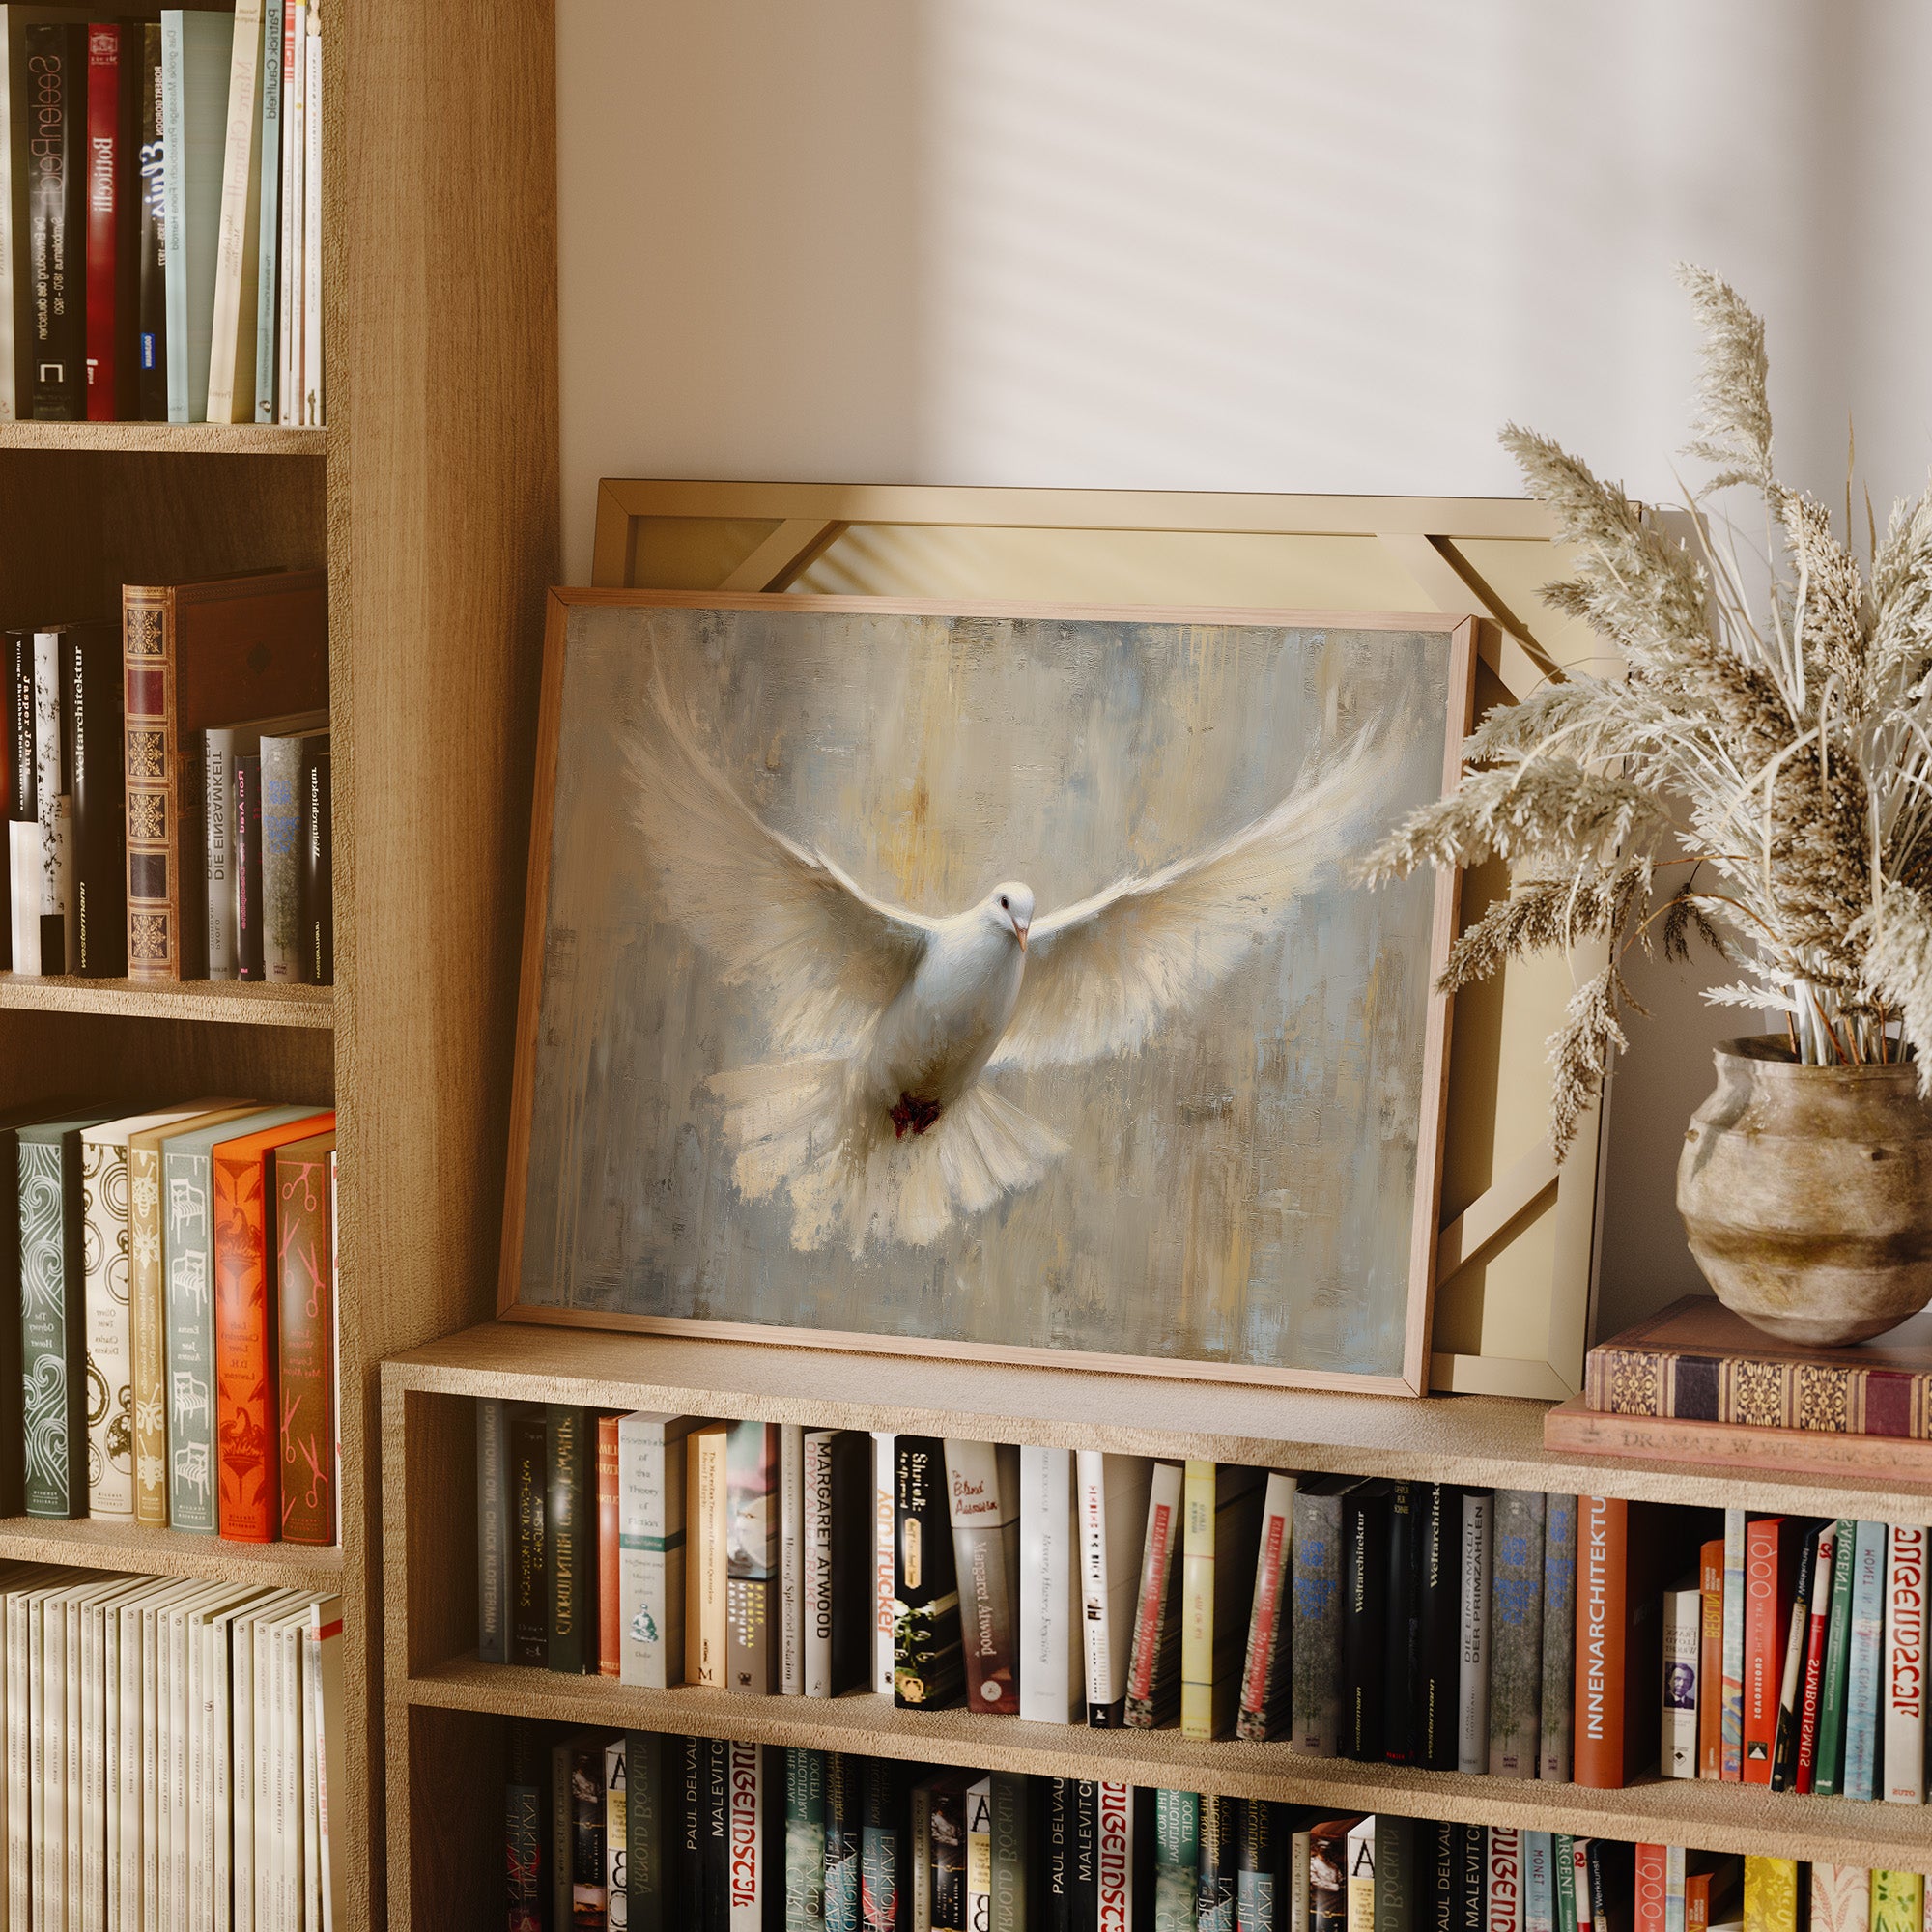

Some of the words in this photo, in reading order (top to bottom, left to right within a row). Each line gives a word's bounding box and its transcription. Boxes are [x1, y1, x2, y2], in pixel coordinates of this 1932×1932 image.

[23, 676, 32, 726] Jasper
[74, 646, 85, 784] Weltarchitektur
[629, 1485, 658, 1497] Theory
[805, 1442, 818, 1491] ORYX
[805, 1498, 817, 1538] AND
[818, 1442, 831, 1550] MARGARET
[805, 1546, 817, 1611] CRAKE
[971, 1541, 990, 1600] Margaret
[1355, 1510, 1365, 1614] Weltarchitektur
[1465, 1522, 1474, 1629] EINSAMKEIT
[1473, 1506, 1483, 1621] PRIMZAHLEN
[817, 1557, 831, 1639] ATWOOD
[978, 1605, 997, 1656] Atwood
[1472, 1628, 1480, 1664] DER
[698, 1667, 712, 1680] M
[686, 1808, 697, 1850] PAUL
[1052, 1850, 1064, 1894] PAUL
[1533, 1849, 1545, 1887] MONET
[1593, 1861, 1604, 1908] Werkkunst
[1636, 1856, 1662, 1919] 1900
